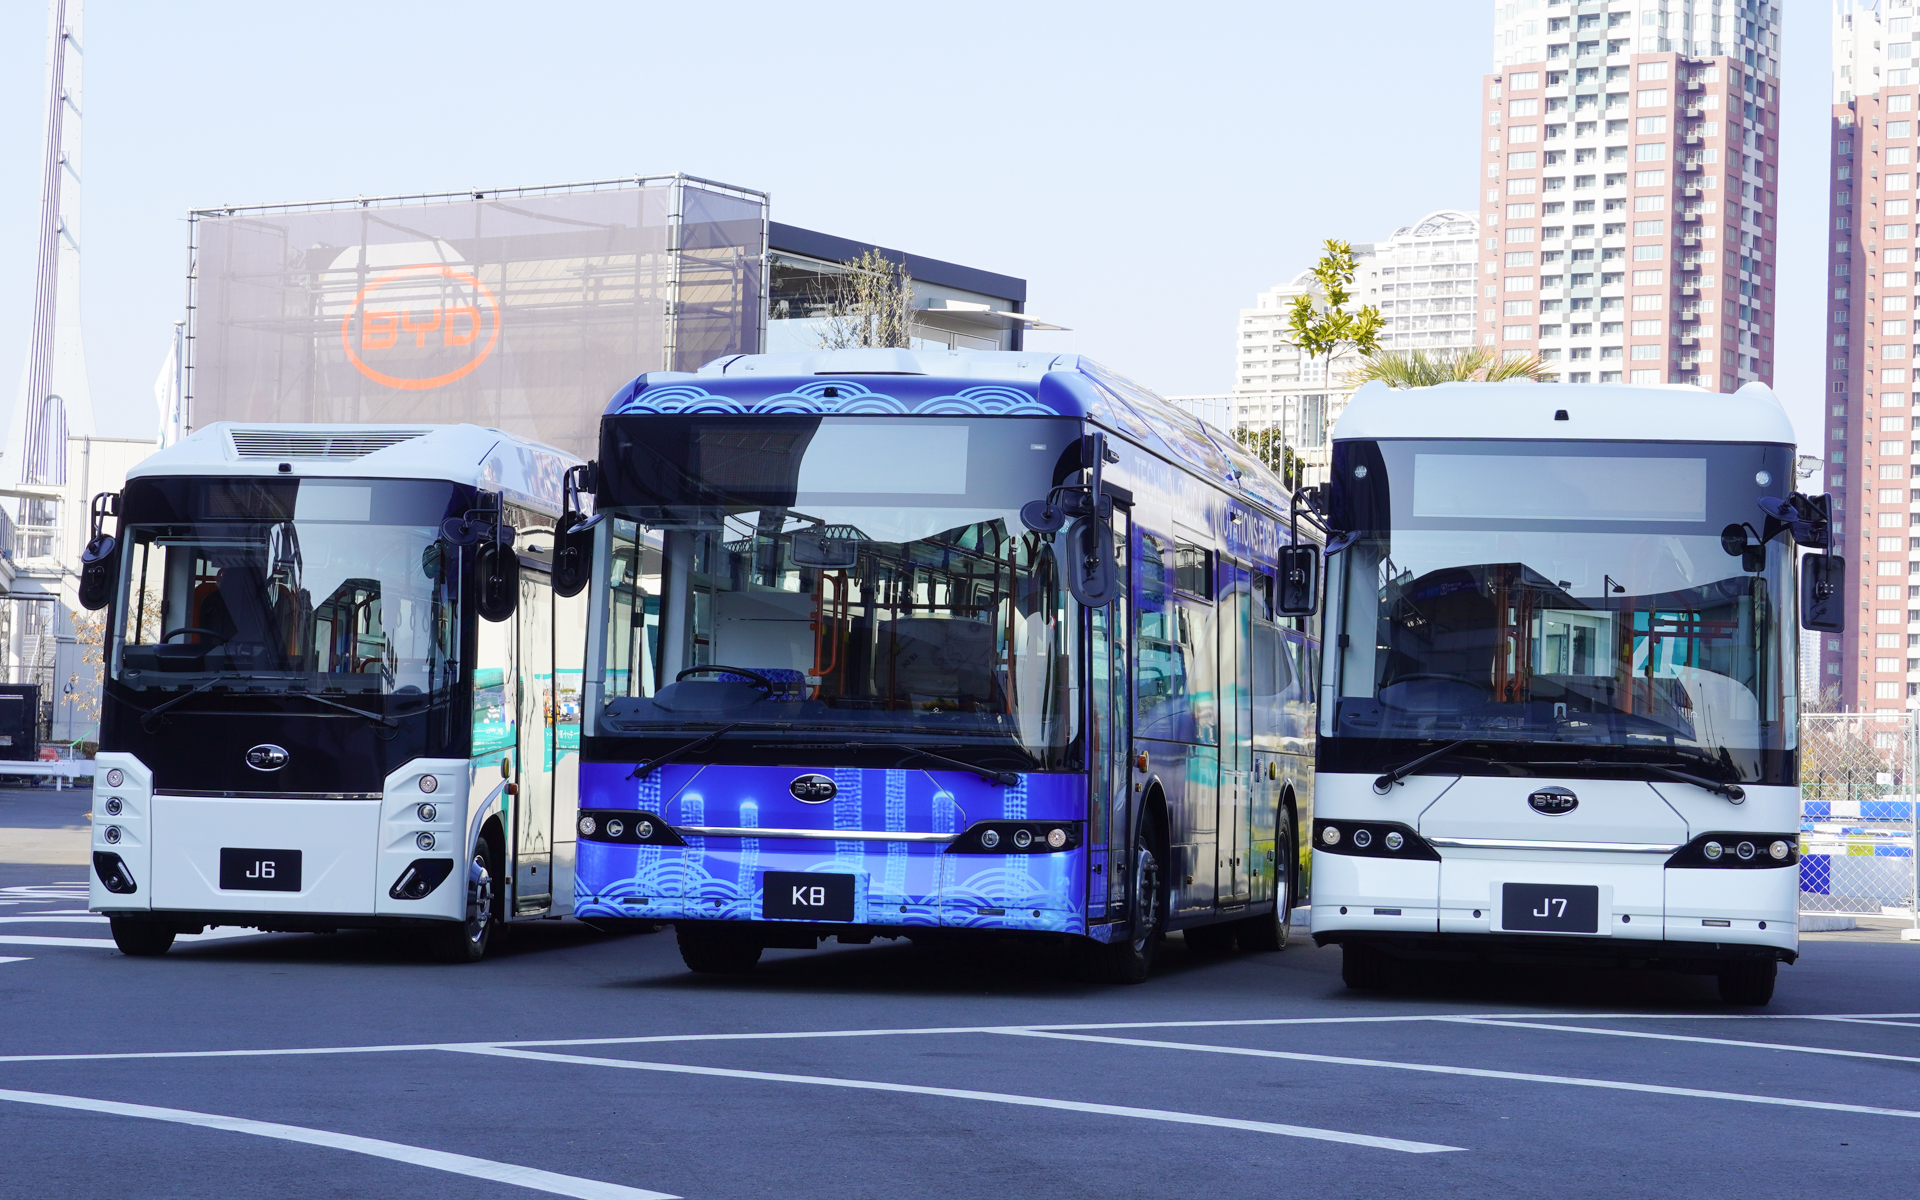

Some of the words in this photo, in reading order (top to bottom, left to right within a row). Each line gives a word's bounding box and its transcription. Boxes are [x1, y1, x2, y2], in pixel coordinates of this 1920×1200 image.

[362, 305, 482, 350] BYD
[1134, 456, 1206, 524] TECHNOLOGICAL
[1209, 495, 1259, 550] INNOVATIONS
[1259, 521, 1272, 557] FOR
[251, 752, 284, 763] BYD
[795, 782, 832, 795] BYD
[1534, 795, 1573, 806] BYD
[246, 861, 276, 878] J6
[792, 886, 825, 906] K8
[1533, 898, 1568, 917] J7
